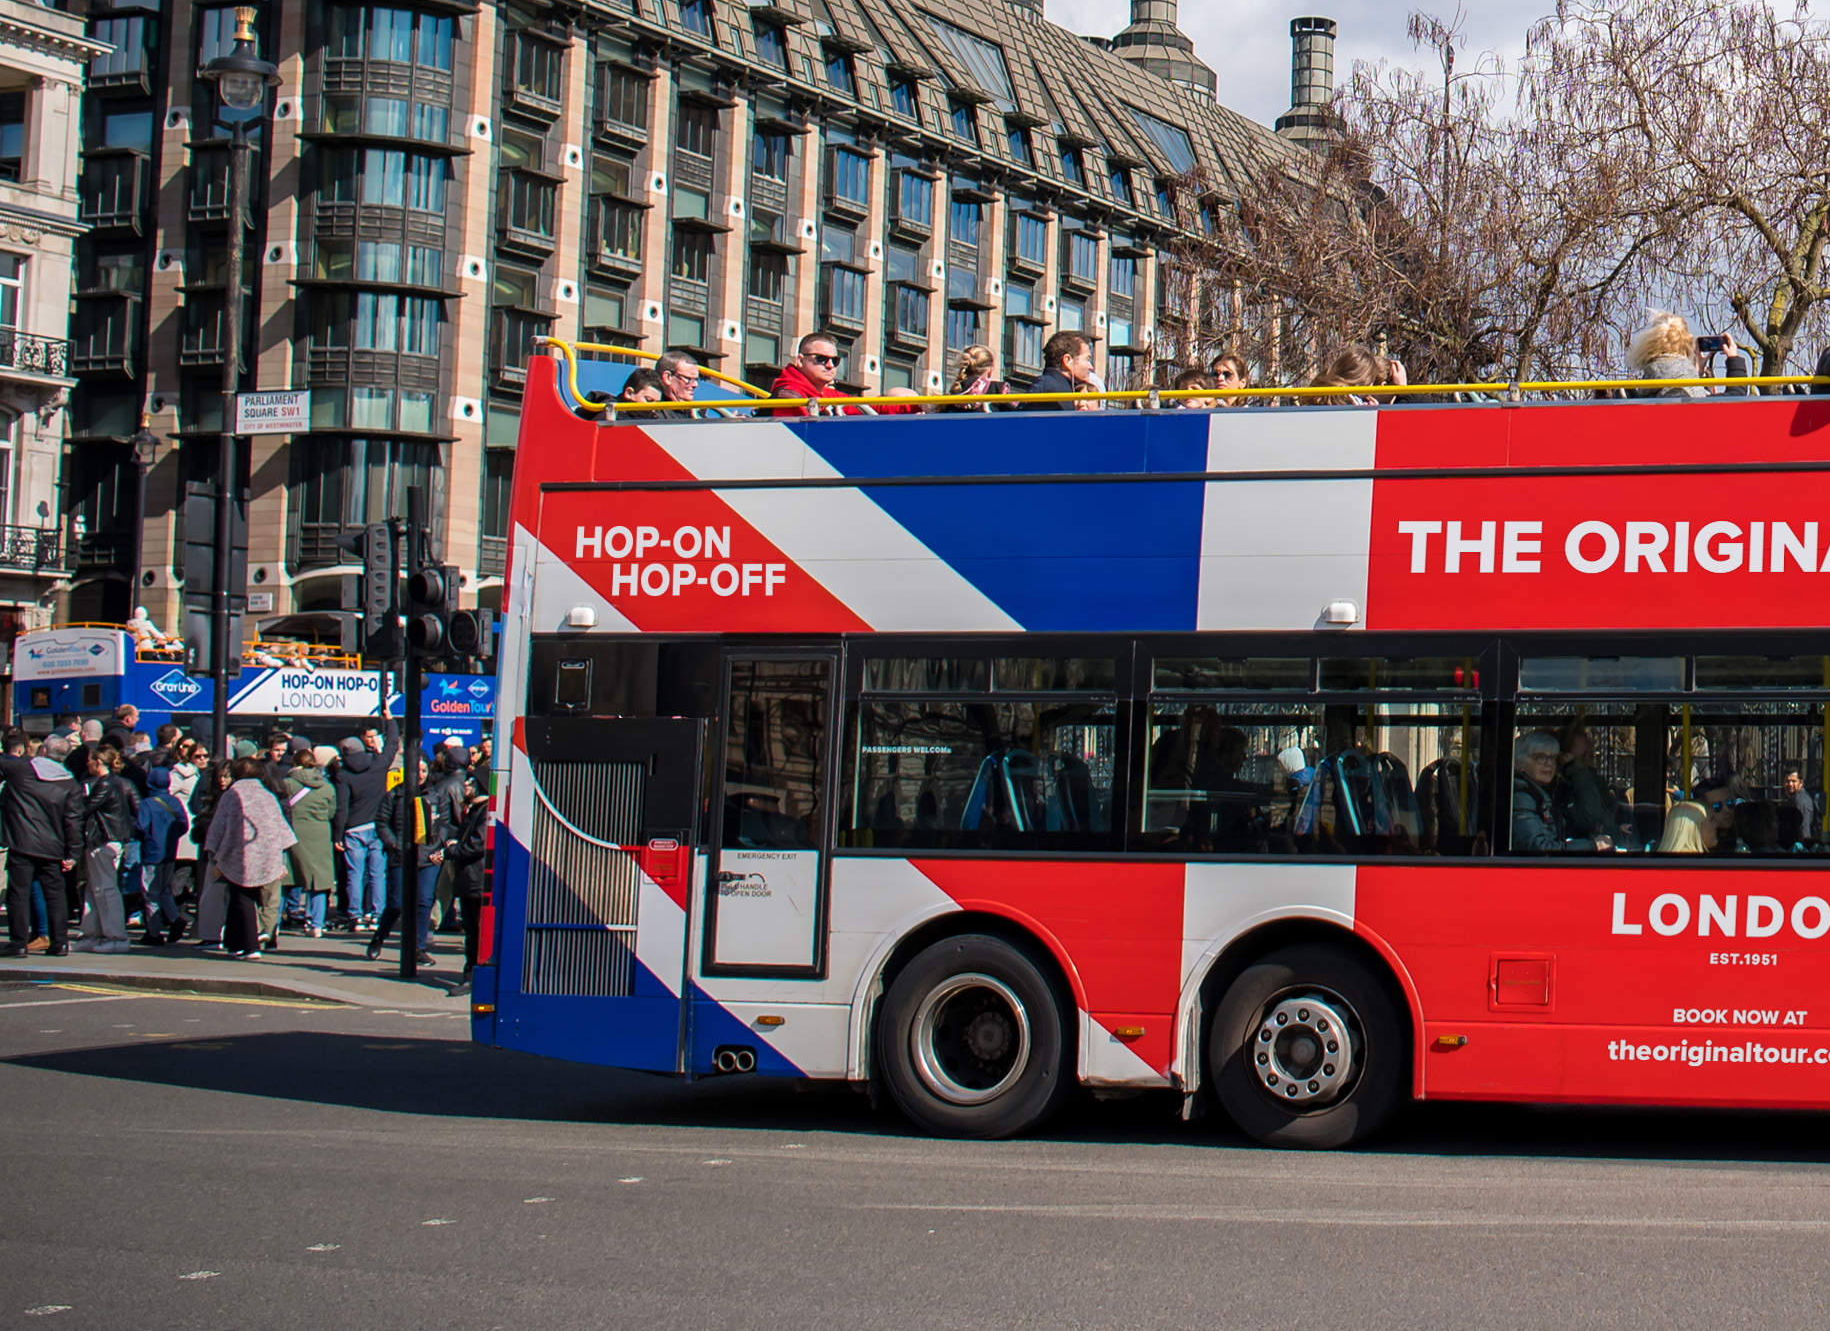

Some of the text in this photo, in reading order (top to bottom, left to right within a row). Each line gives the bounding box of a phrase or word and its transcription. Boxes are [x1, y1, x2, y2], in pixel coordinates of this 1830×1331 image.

[244, 394, 299, 406] PARLIAMENT
[244, 407, 300, 418] SQUARE SW1
[576, 525, 731, 559] HOP-ON
[1398, 520, 1543, 573] THE
[611, 563, 786, 597] HOP-OFF
[281, 674, 334, 690] HOP-ON
[281, 692, 346, 709] LONDON
[862, 745, 912, 754] PASSENGERS
[737, 852, 781, 860] EMERGENCY
[1709, 953, 1778, 965] EST.1951
[1673, 1008, 1808, 1025] BOOK NOW AT
